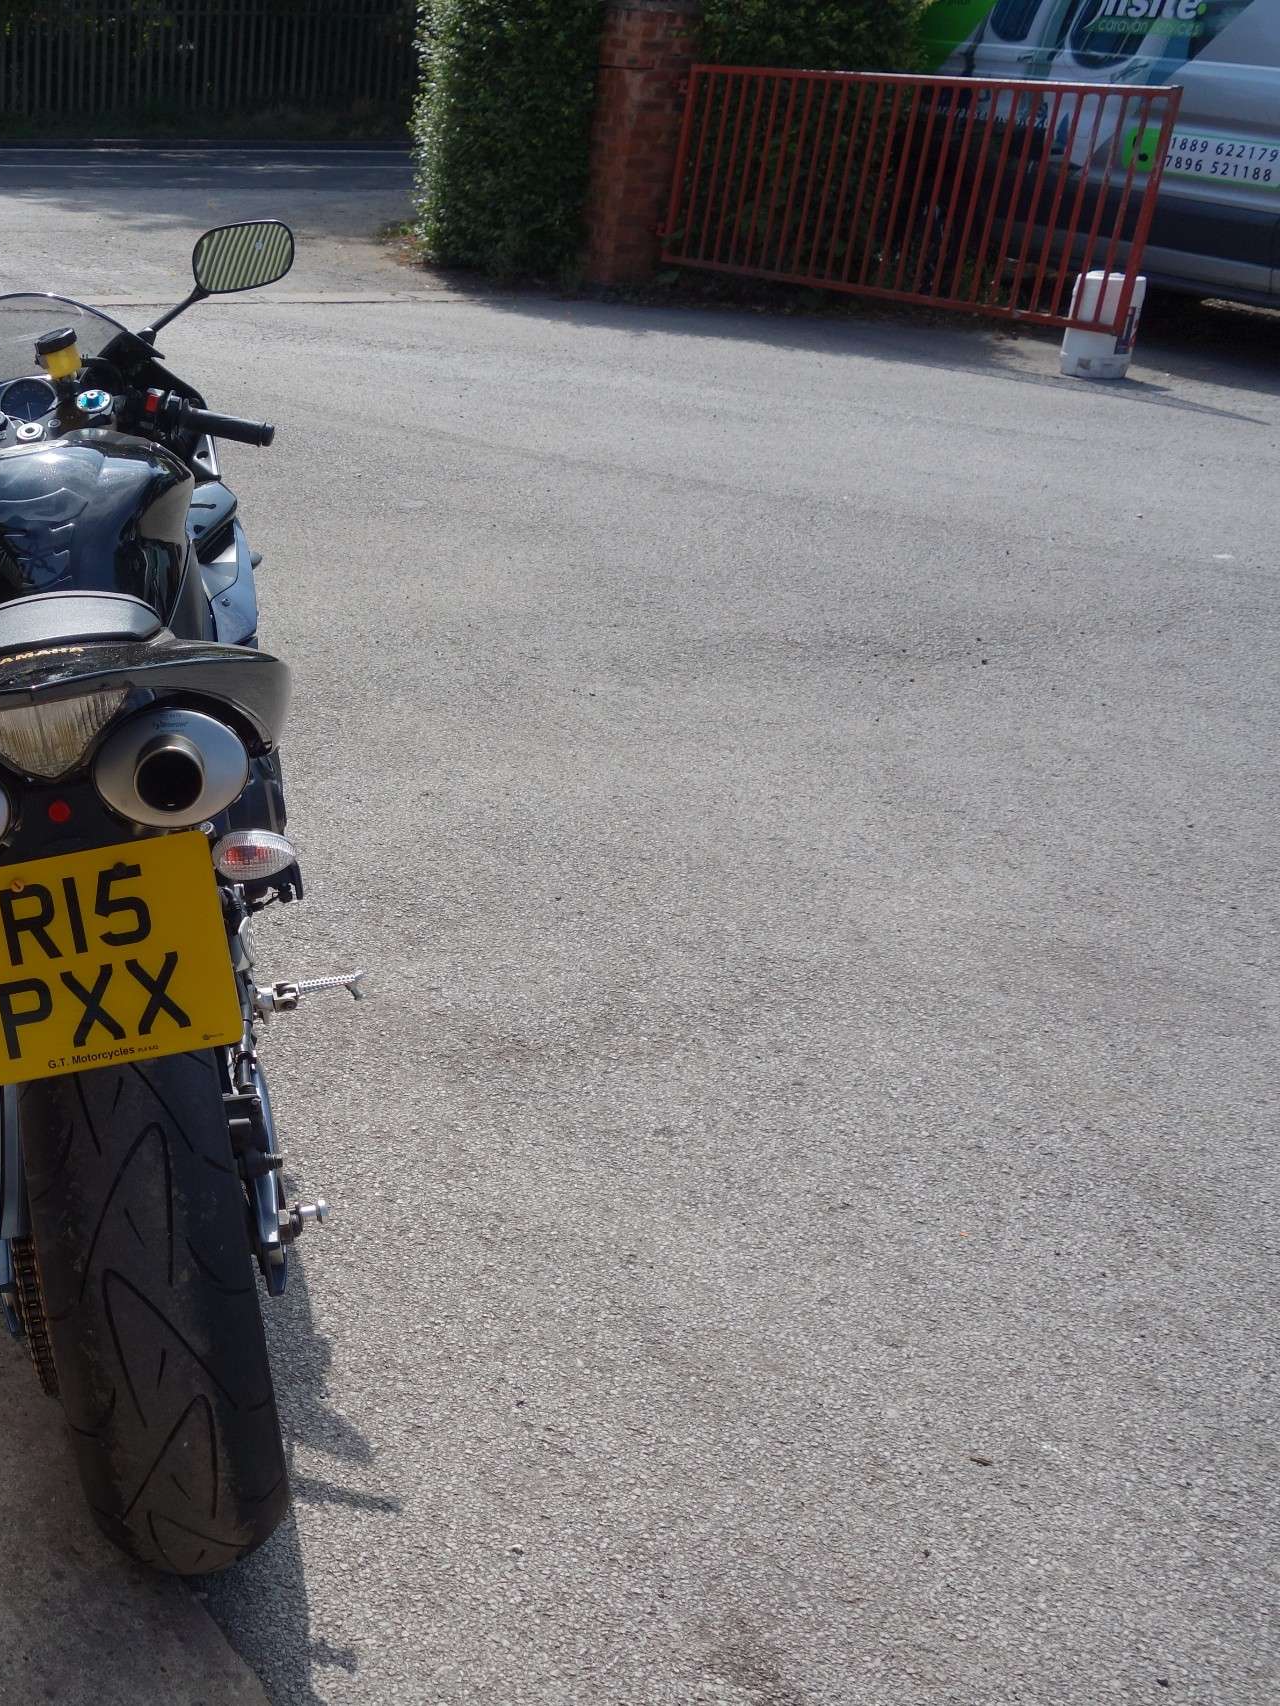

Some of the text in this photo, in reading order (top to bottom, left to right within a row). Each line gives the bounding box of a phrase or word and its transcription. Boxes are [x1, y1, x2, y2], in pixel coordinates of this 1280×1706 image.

[1216, 142, 1279, 162] 622179
[1209, 161, 1273, 182] 521188
[48, 1057, 70, 1069] G.T.
[72, 1046, 135, 1065] Motorcycles
